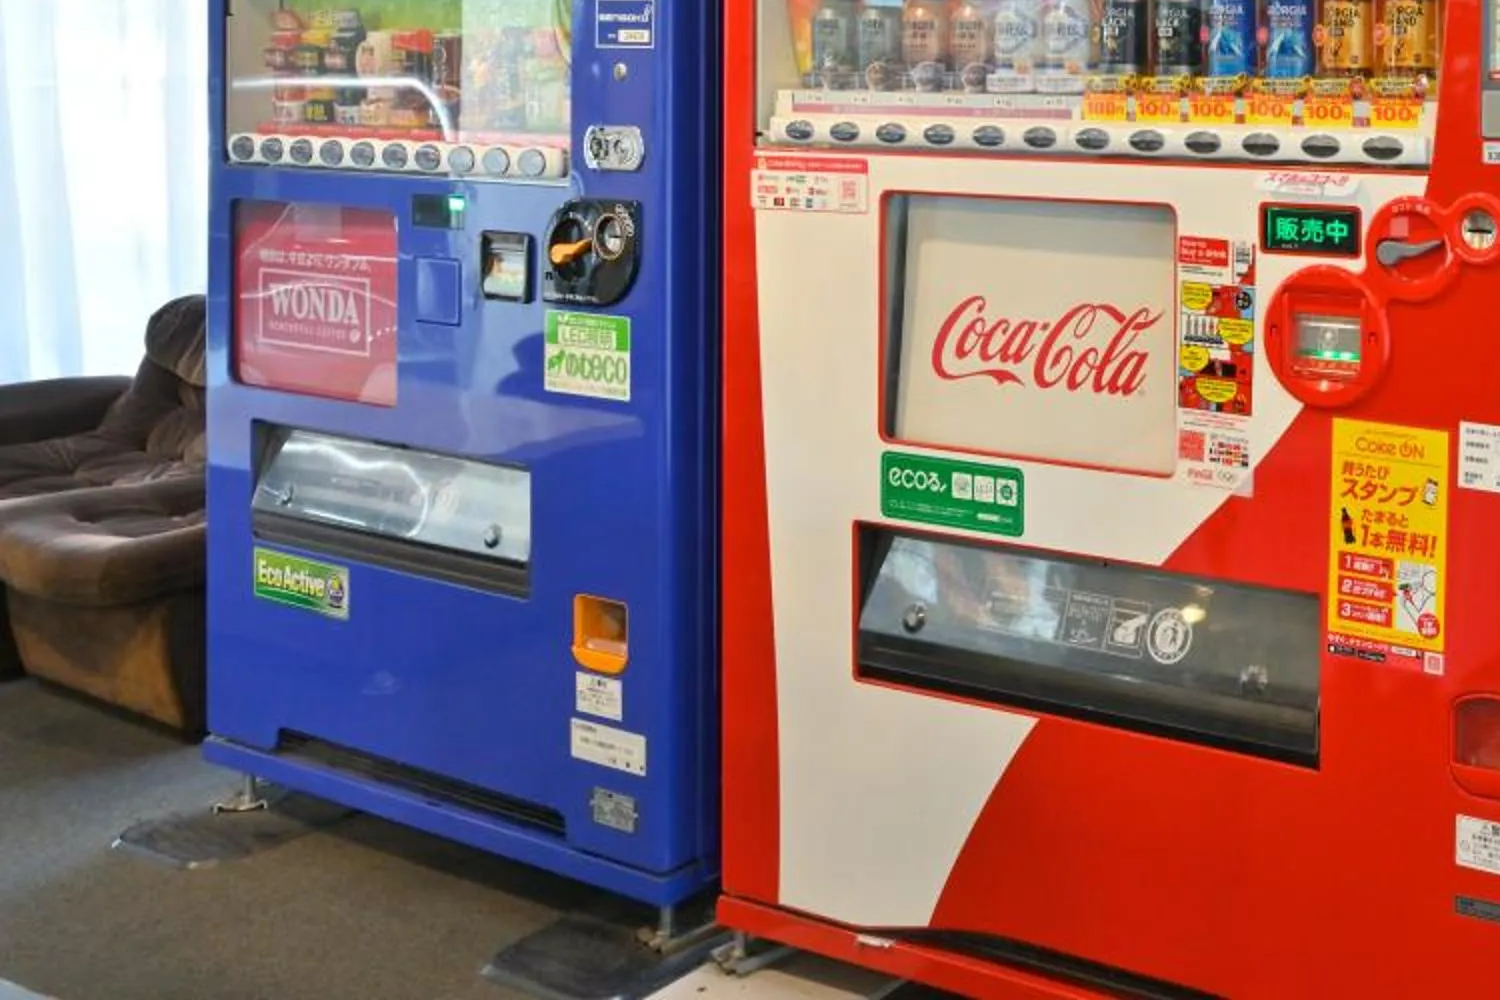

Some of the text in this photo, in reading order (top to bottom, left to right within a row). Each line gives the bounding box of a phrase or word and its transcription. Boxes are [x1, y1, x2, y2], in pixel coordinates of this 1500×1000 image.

[1275, 216, 1349, 244] 販売中
[267, 283, 361, 326] WONDA
[931, 295, 1165, 397] Coca-Cola
[1355, 436, 1425, 459] Coke ON
[1341, 460, 1390, 479] 買うたび
[1341, 477, 1418, 507] スタンプ
[1361, 508, 1410, 528] たまると
[1360, 523, 1438, 559] 1本無料!
[258, 560, 325, 597] Eco Active
